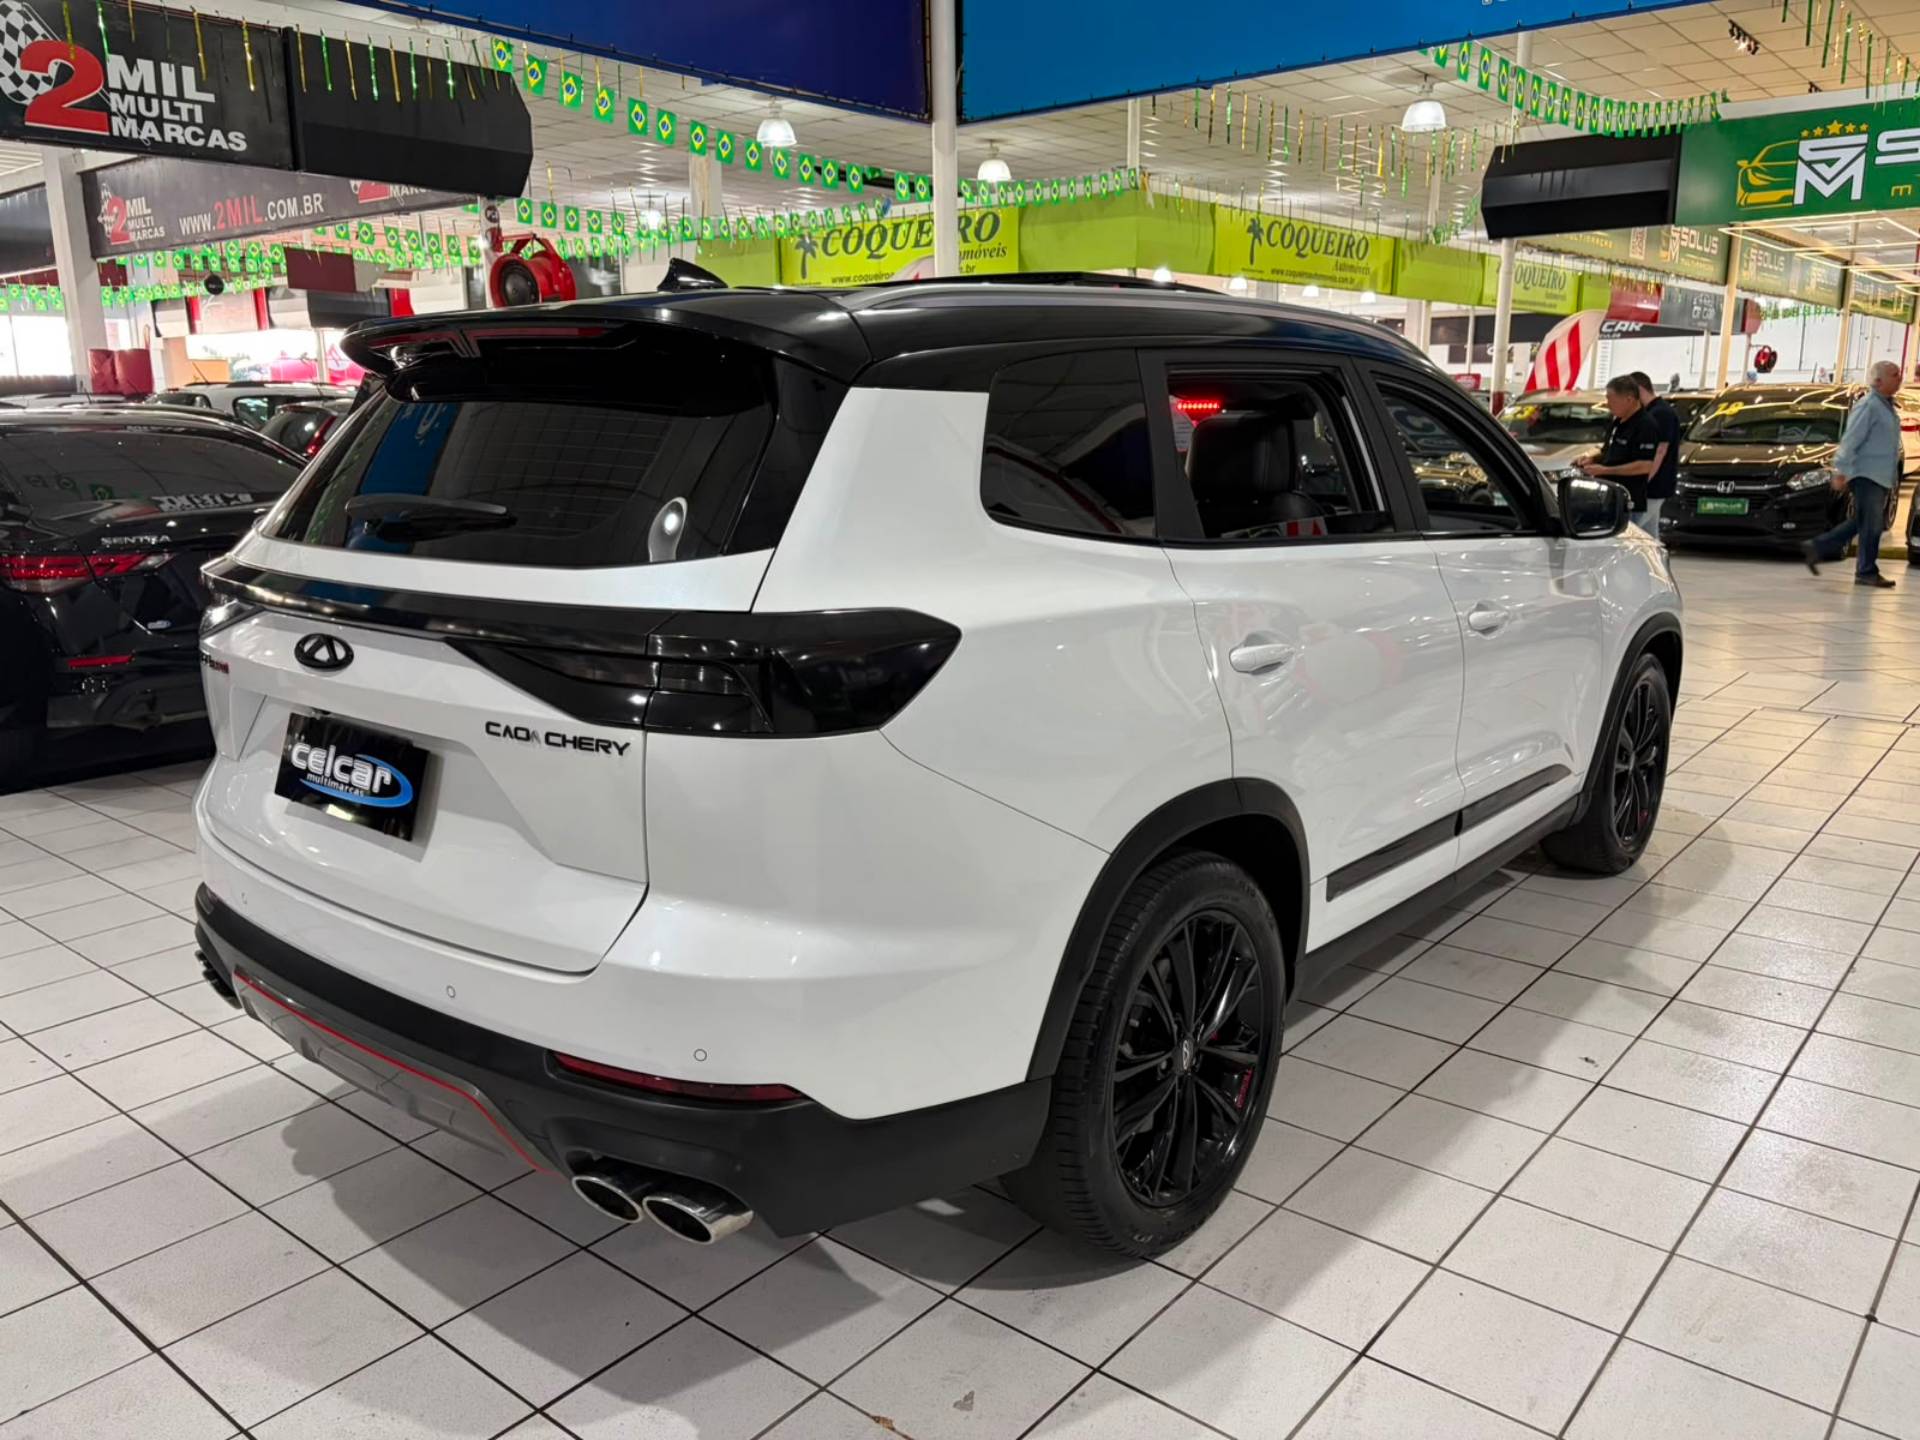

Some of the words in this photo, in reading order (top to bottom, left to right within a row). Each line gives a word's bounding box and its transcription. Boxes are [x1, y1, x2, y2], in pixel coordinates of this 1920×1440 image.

[20, 40, 110, 136] 2
[107, 53, 216, 103] MIL
[110, 92, 203, 124] MULTI
[111, 116, 248, 151] MARCAS
[108, 196, 130, 245] 2
[126, 197, 152, 217] MIL
[127, 215, 154, 231] MULTI
[178, 193, 325, 236] WWW.2MIL.COM.BR
[129, 226, 165, 242] MARCAS
[821, 211, 1001, 259] COQUERO
[1266, 220, 1370, 261] COQUEIRO
[1680, 226, 1720, 256] SOLUS
[1514, 263, 1567, 290] OQUEIRO
[1601, 321, 1643, 333] CAR
[544, 731, 632, 757] CHERY
[291, 742, 392, 793] celcar
[306, 773, 365, 798] multimarcas
